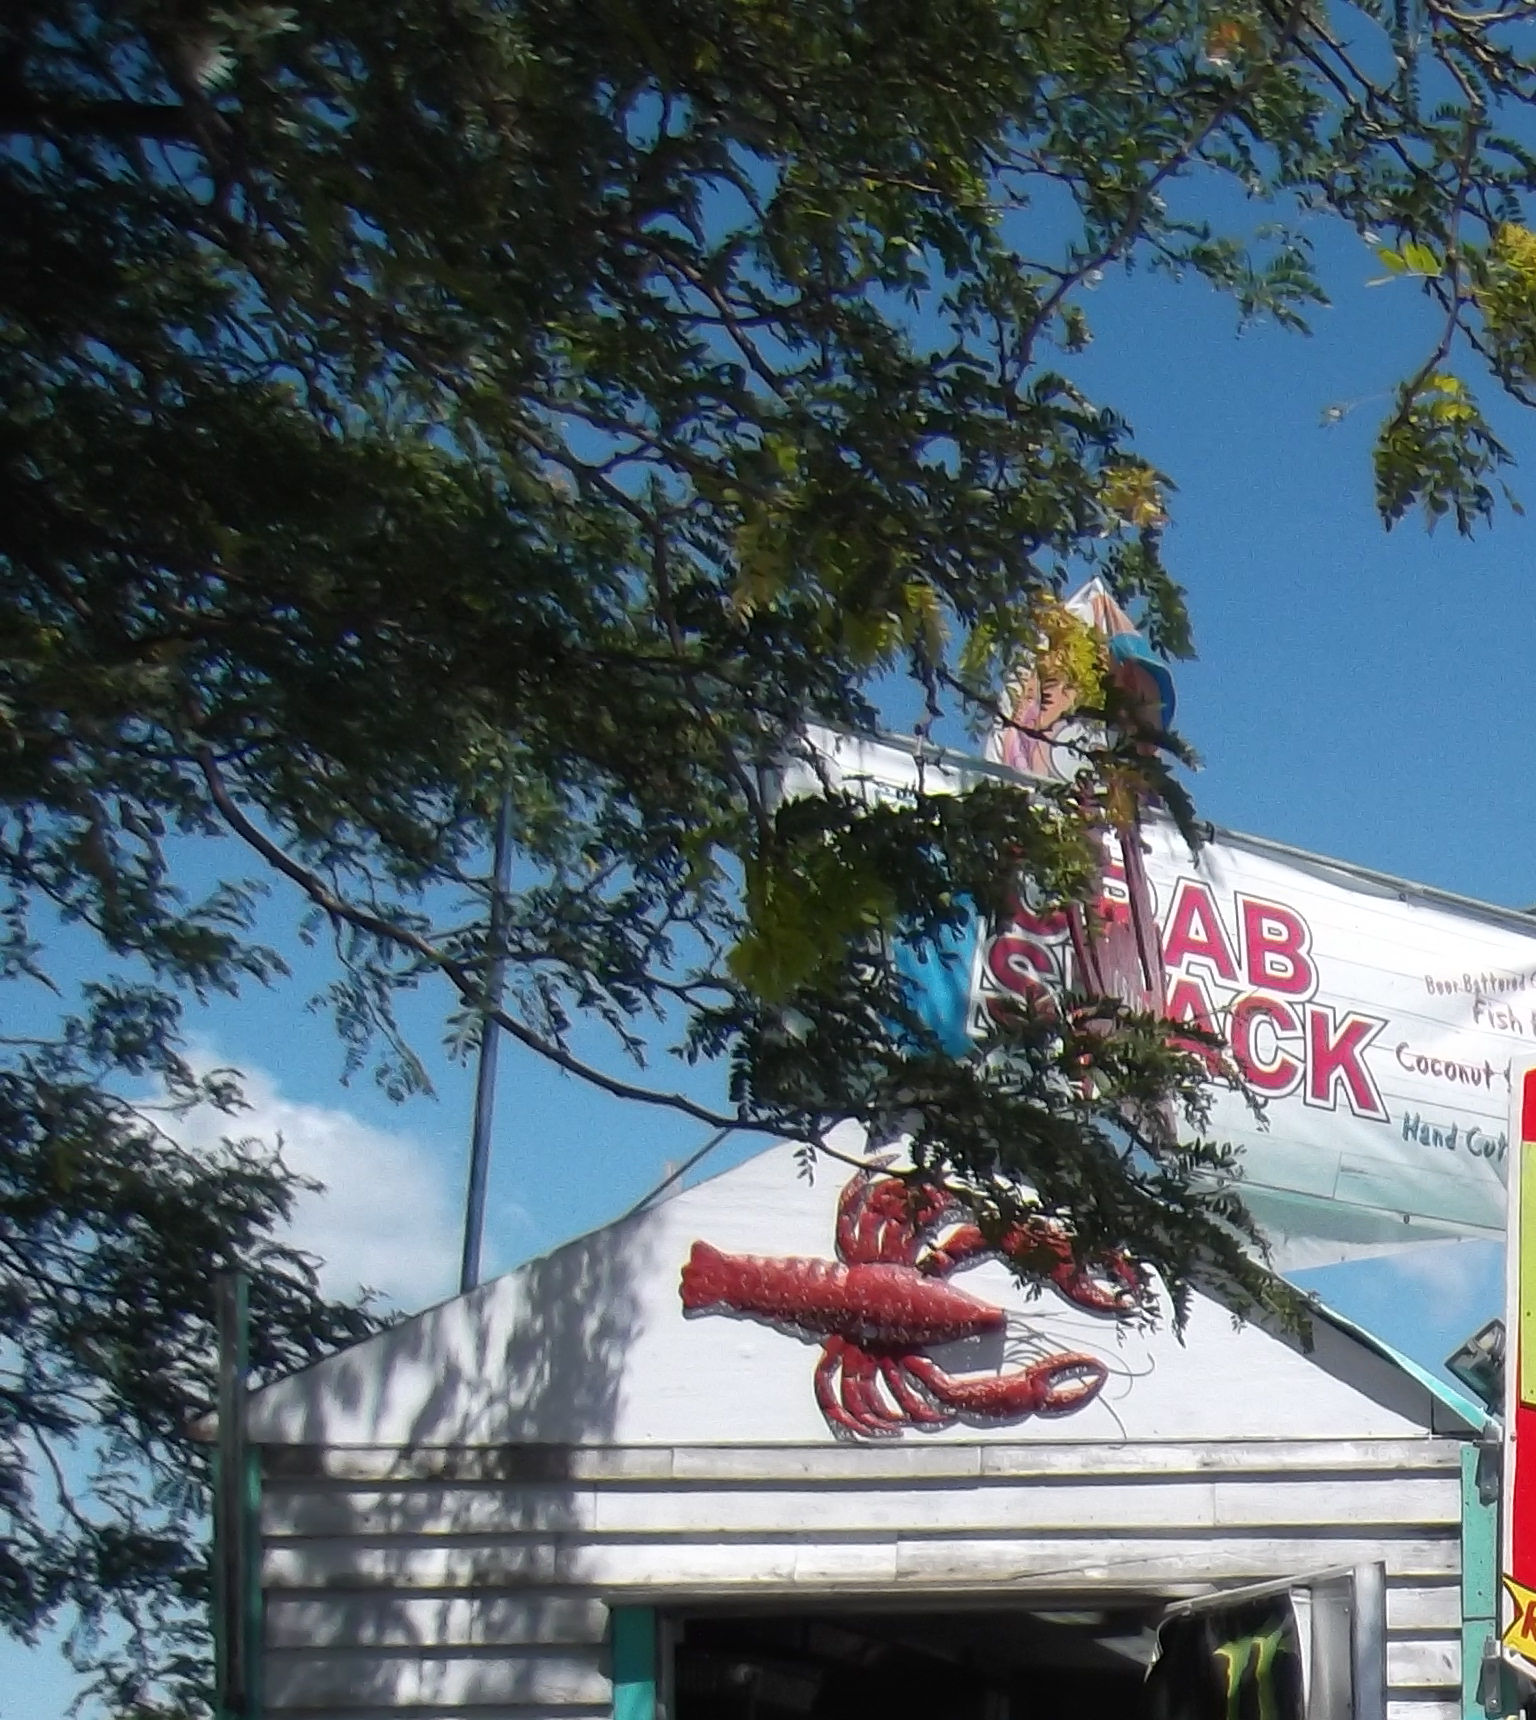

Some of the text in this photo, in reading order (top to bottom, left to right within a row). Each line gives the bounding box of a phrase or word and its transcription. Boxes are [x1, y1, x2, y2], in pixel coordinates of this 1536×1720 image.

[985, 935, 1390, 1123] SACK
[1472, 997, 1523, 1035] Fish
[1395, 1041, 1493, 1090] Coconut
[1401, 1110, 1458, 1151] Hand
